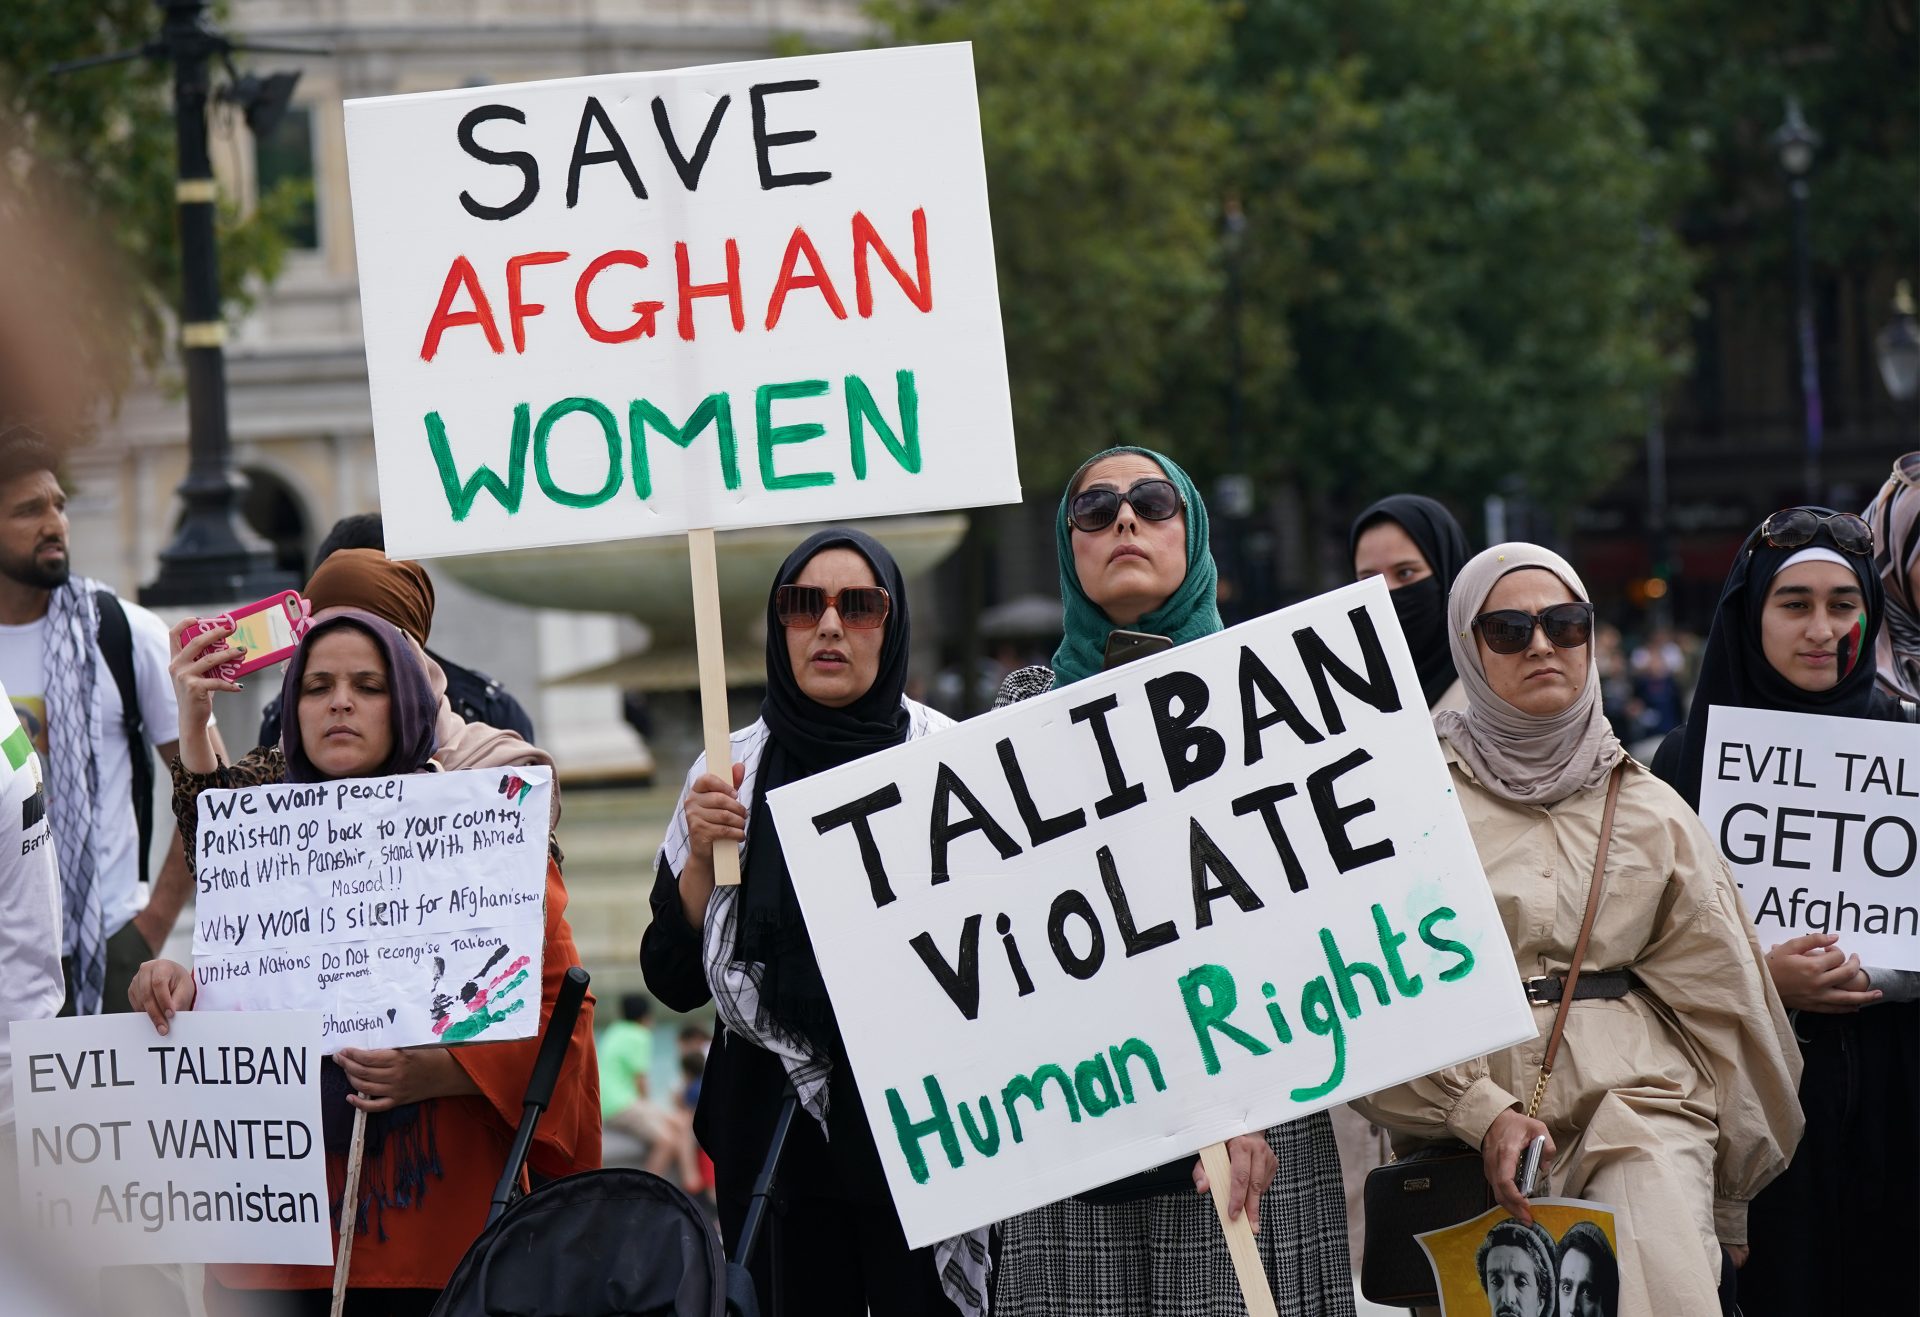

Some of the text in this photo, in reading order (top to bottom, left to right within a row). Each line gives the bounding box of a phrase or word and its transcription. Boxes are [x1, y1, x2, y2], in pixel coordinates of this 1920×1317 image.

[457, 79, 832, 221] SAVE
[420, 205, 933, 363] AFGHAN
[424, 369, 922, 523] WOMEN
[812, 605, 1402, 907] TALIBAN
[1718, 741, 1920, 797] EVIL TAL
[205, 792, 258, 821] We
[297, 820, 319, 851] go
[328, 819, 363, 845] back
[377, 819, 396, 840] to
[201, 913, 250, 946] Why
[416, 892, 443, 925] for
[1754, 886, 1919, 936] Afghan
[322, 952, 341, 971] Do
[29, 1046, 307, 1092] EVIL TALIBAN
[885, 903, 1475, 1184] Human Rights
[32, 1119, 312, 1167] NOT WANTED
[36, 1180, 320, 1232] in Afghanistan
